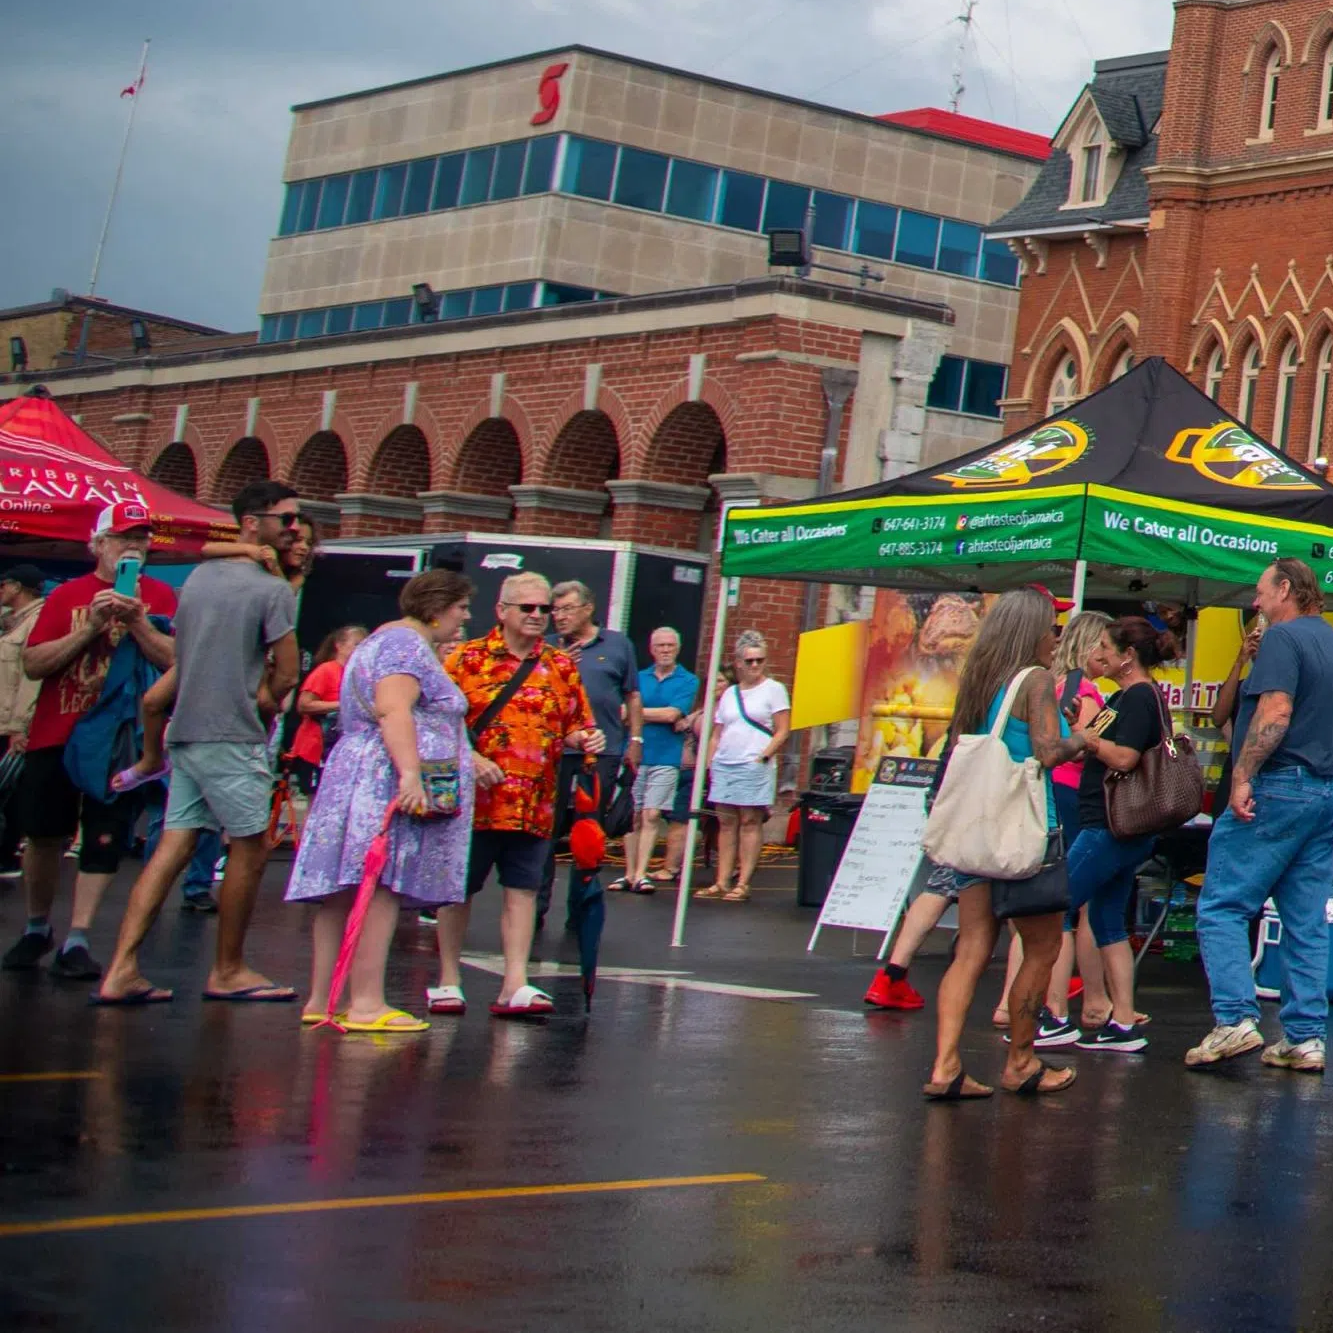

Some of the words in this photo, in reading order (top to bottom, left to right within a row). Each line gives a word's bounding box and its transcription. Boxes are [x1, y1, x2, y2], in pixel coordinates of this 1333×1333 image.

[0, 467, 139, 492] RIBBEAN
[0, 479, 149, 510] LAVAH
[883, 517, 946, 531] 647-641-3174
[969, 510, 1065, 530] @ahtasteofjamaica
[733, 528, 749, 545] We
[751, 527, 779, 543] Cater
[780, 525, 794, 542] all
[796, 523, 848, 540] Occasions
[1104, 511, 1130, 531] We
[1134, 517, 1174, 539] Cater
[1178, 525, 1197, 543] all
[1200, 529, 1278, 554] Occasions
[879, 542, 943, 556] 647-885-3174
[967, 536, 1053, 555] ahtasteofjamaica
[1161, 683, 1201, 707] Hafi
